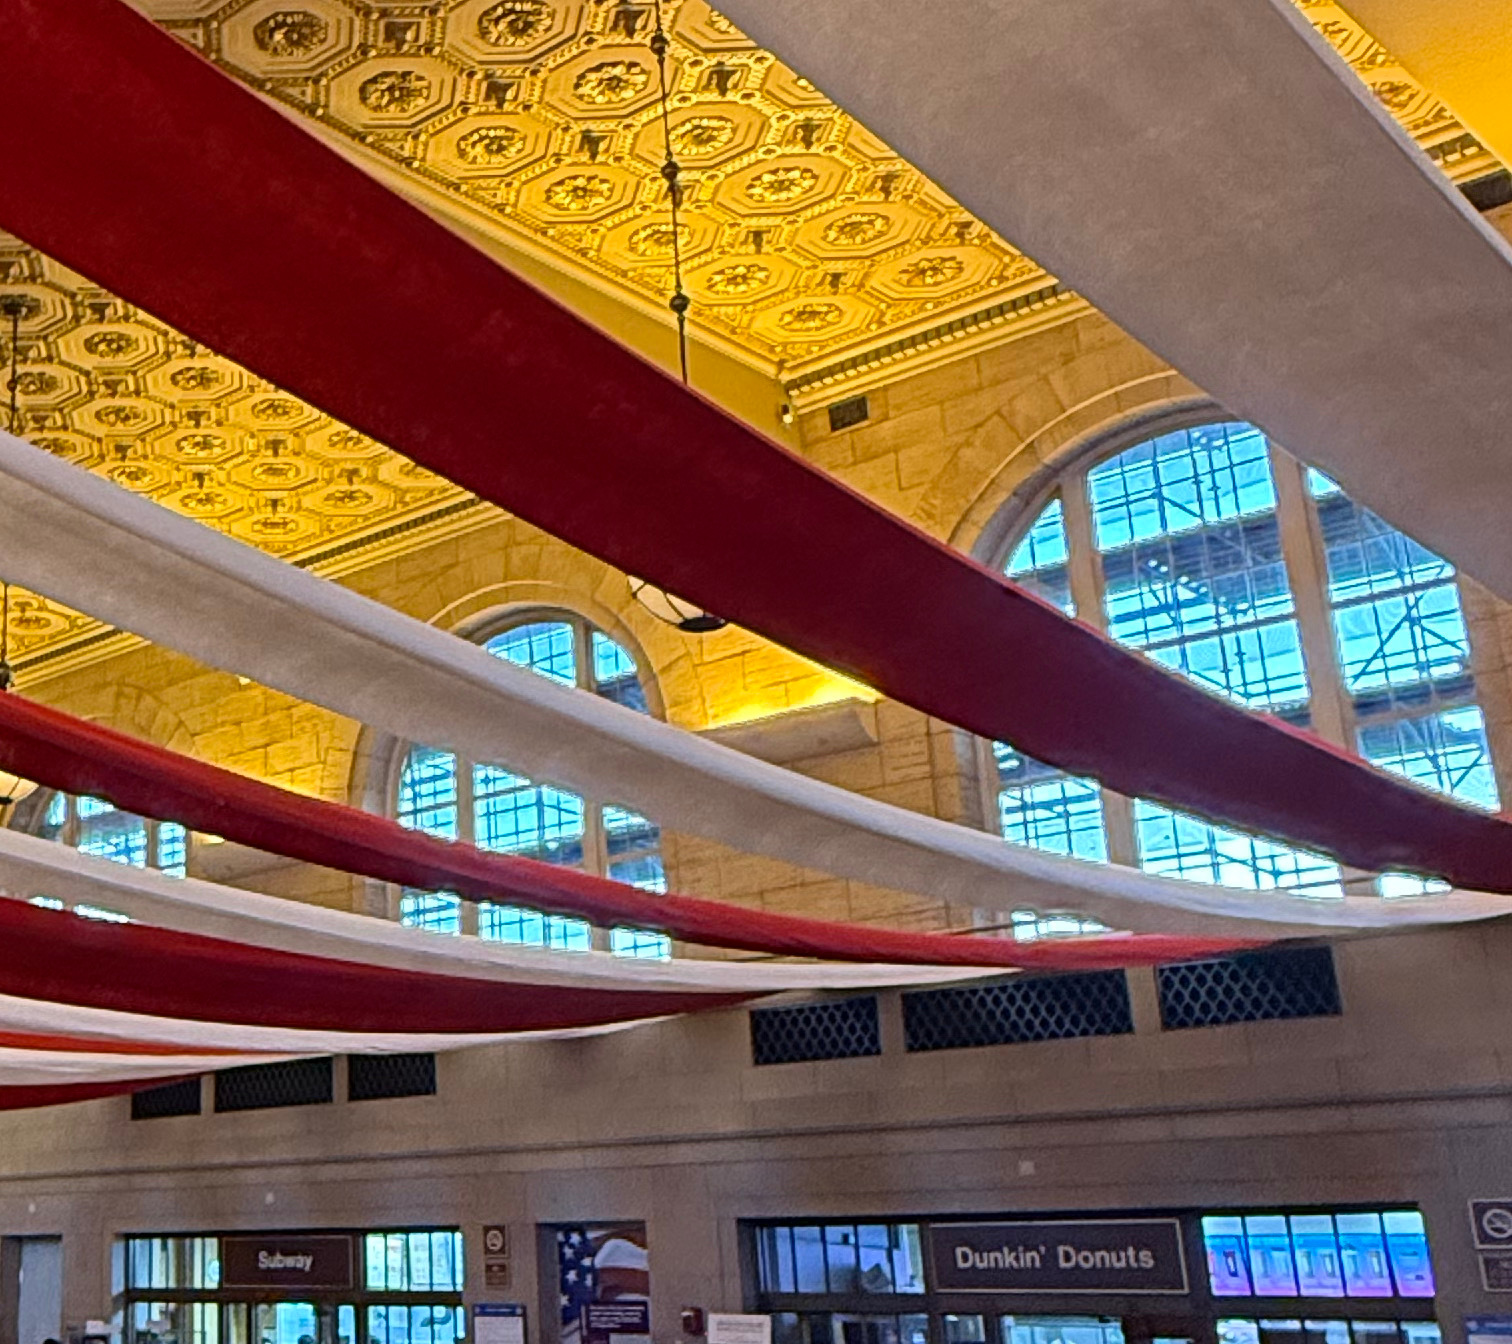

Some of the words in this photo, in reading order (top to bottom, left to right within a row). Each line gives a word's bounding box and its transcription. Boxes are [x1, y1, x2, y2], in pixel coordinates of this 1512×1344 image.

[258, 1250, 313, 1272] Subway
[955, 1246, 1046, 1269] Dunkin'
[1057, 1245, 1155, 1269] Donuts
